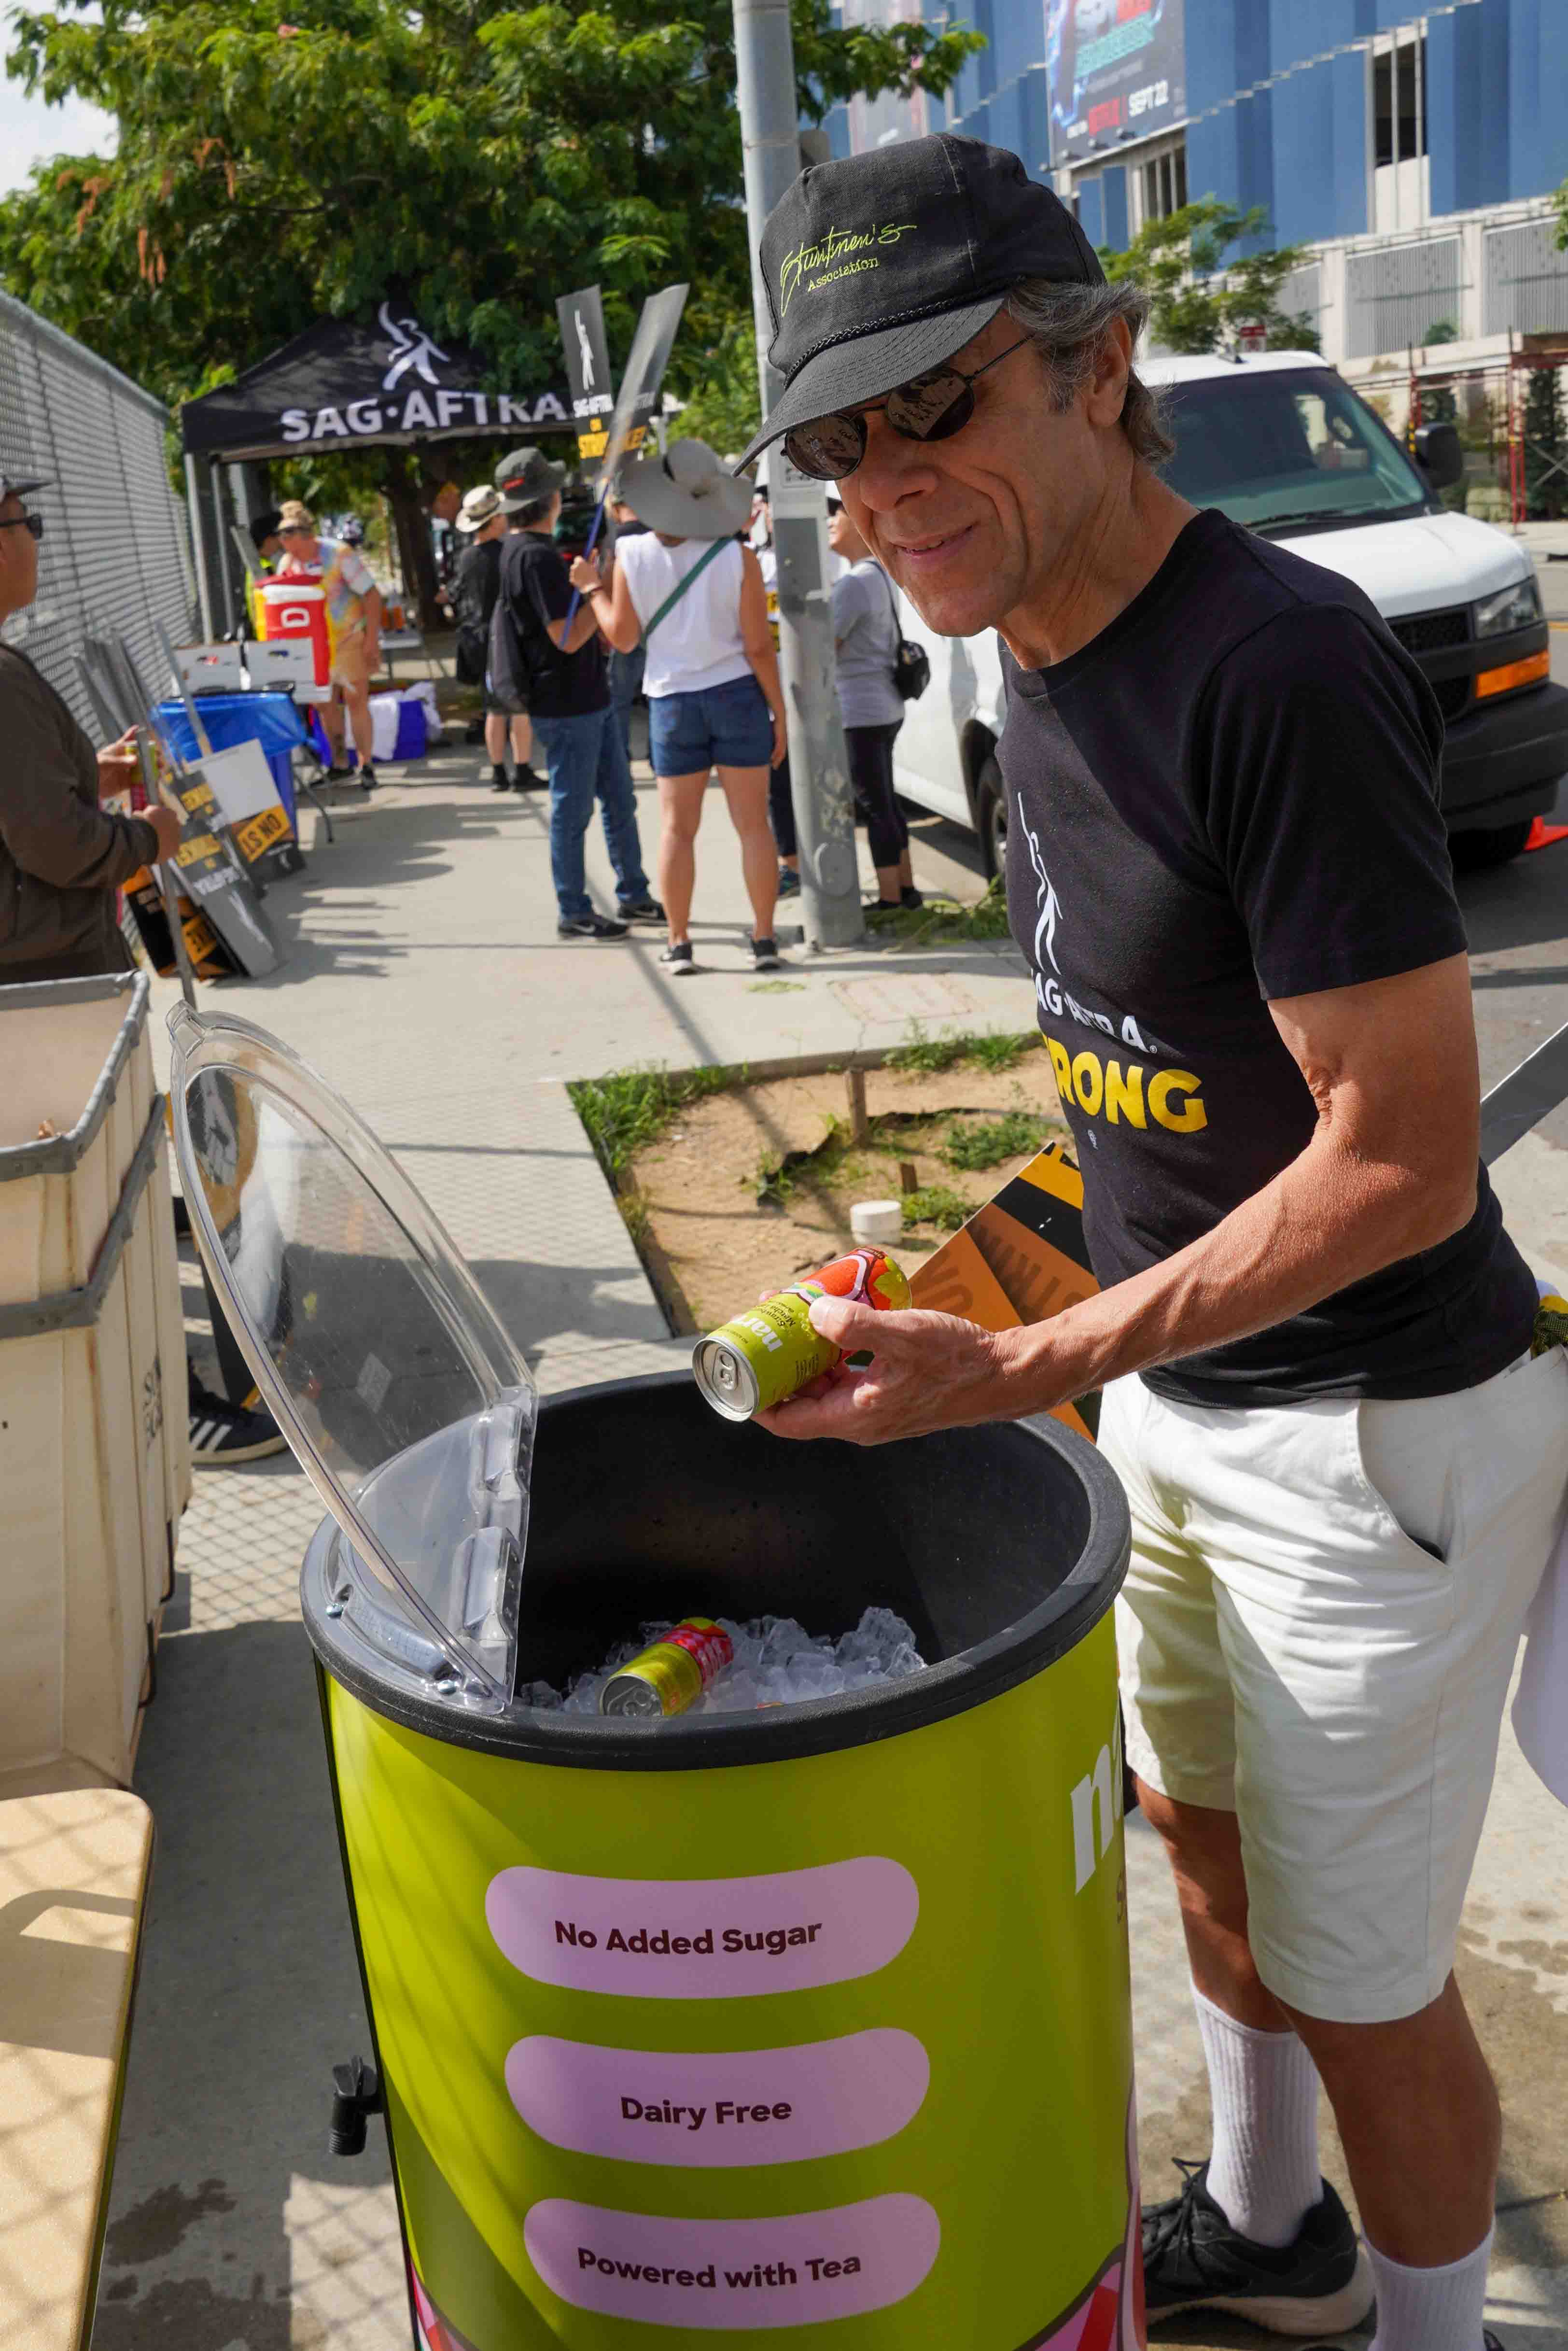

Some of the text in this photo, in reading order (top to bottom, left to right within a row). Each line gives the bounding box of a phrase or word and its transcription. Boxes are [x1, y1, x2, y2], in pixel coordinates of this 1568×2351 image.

[806, 256, 880, 294] Association
[555, 1920, 822, 1955] No Added Sugar
[621, 2097, 792, 2130] Dairy Free
[578, 2248, 861, 2288] Powered with Tea
